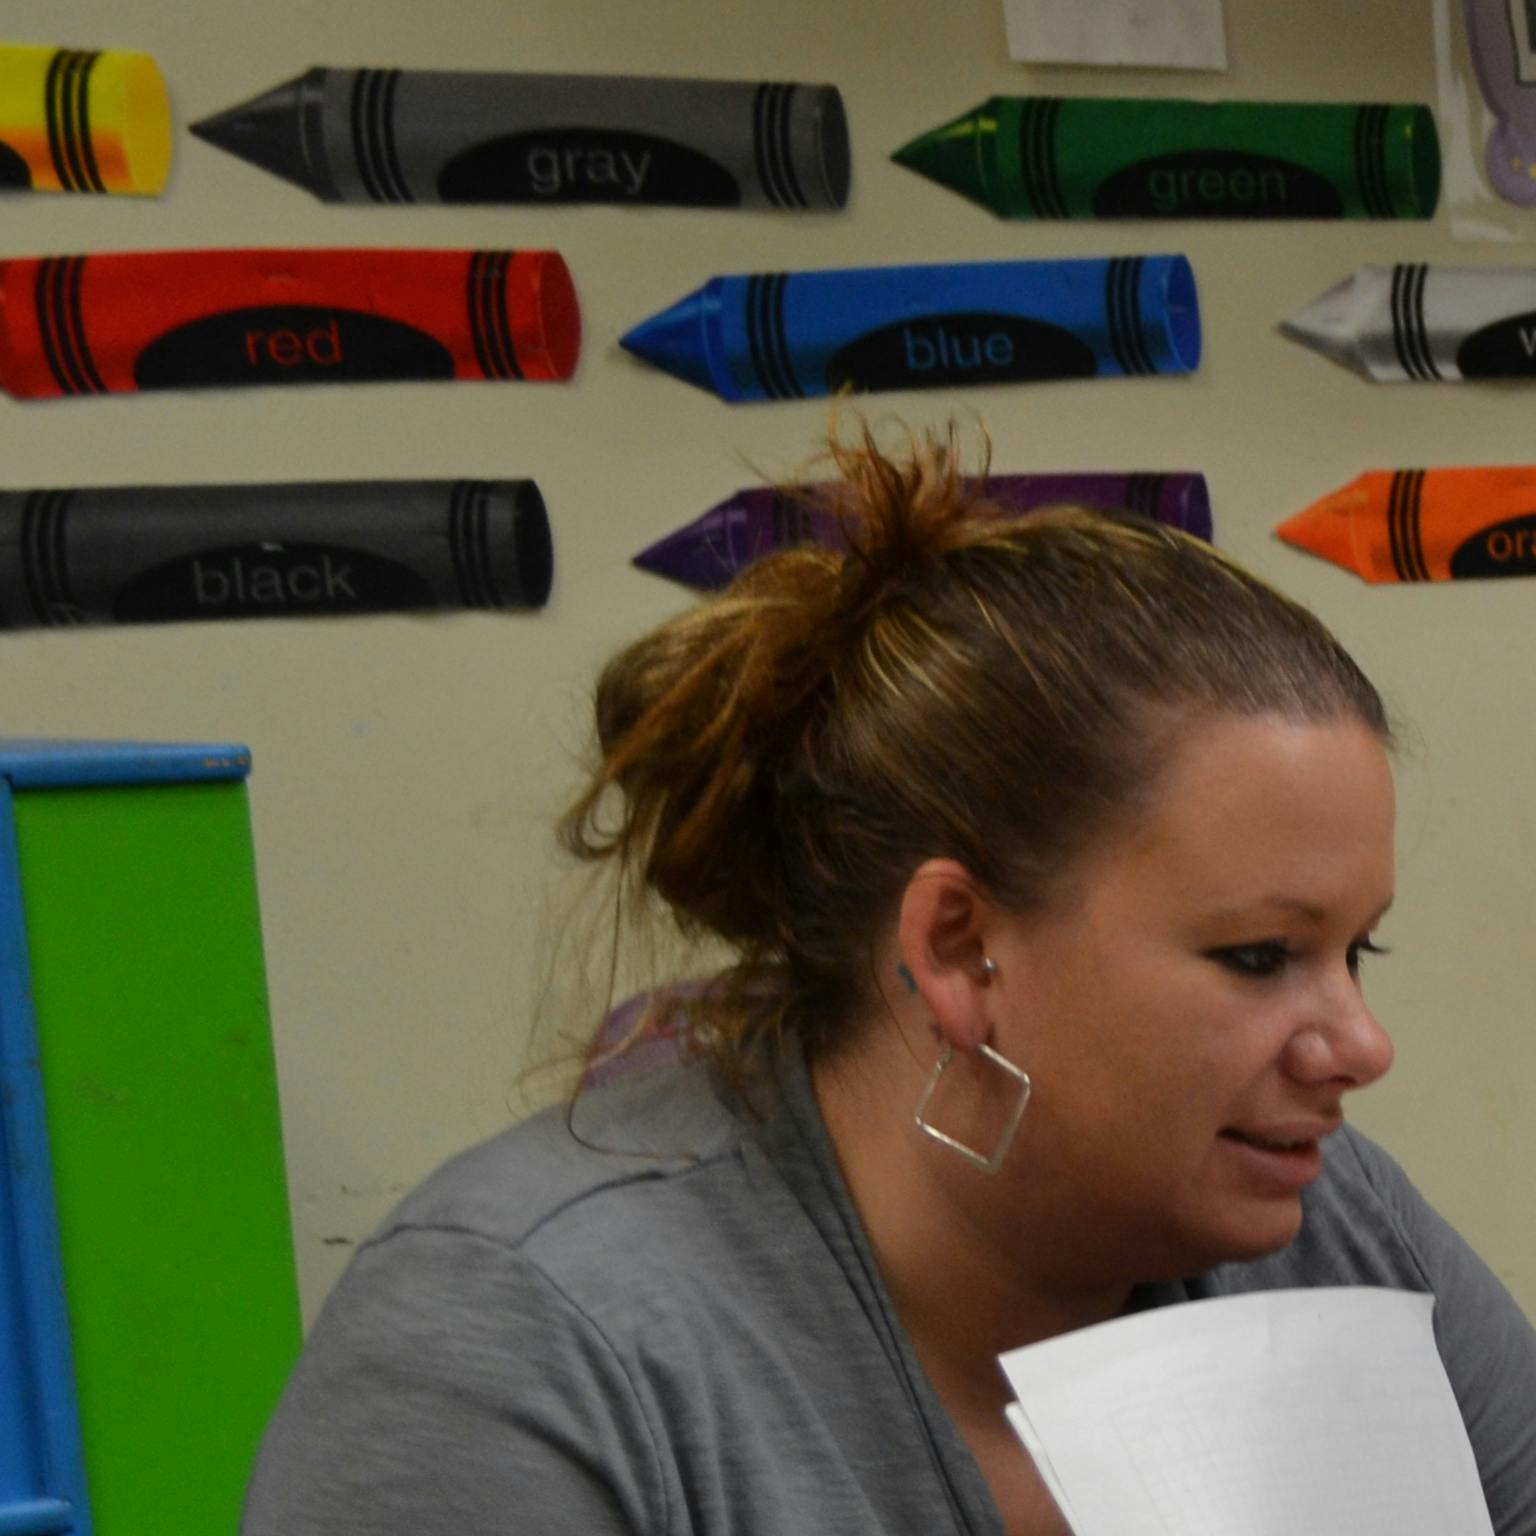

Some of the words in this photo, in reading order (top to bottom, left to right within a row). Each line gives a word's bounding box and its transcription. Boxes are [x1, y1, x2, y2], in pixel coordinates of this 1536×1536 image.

[527, 146, 650, 195] gray
[1149, 167, 1287, 211] green
[244, 318, 342, 366] red
[903, 325, 1014, 369] blue
[193, 553, 356, 603] black
